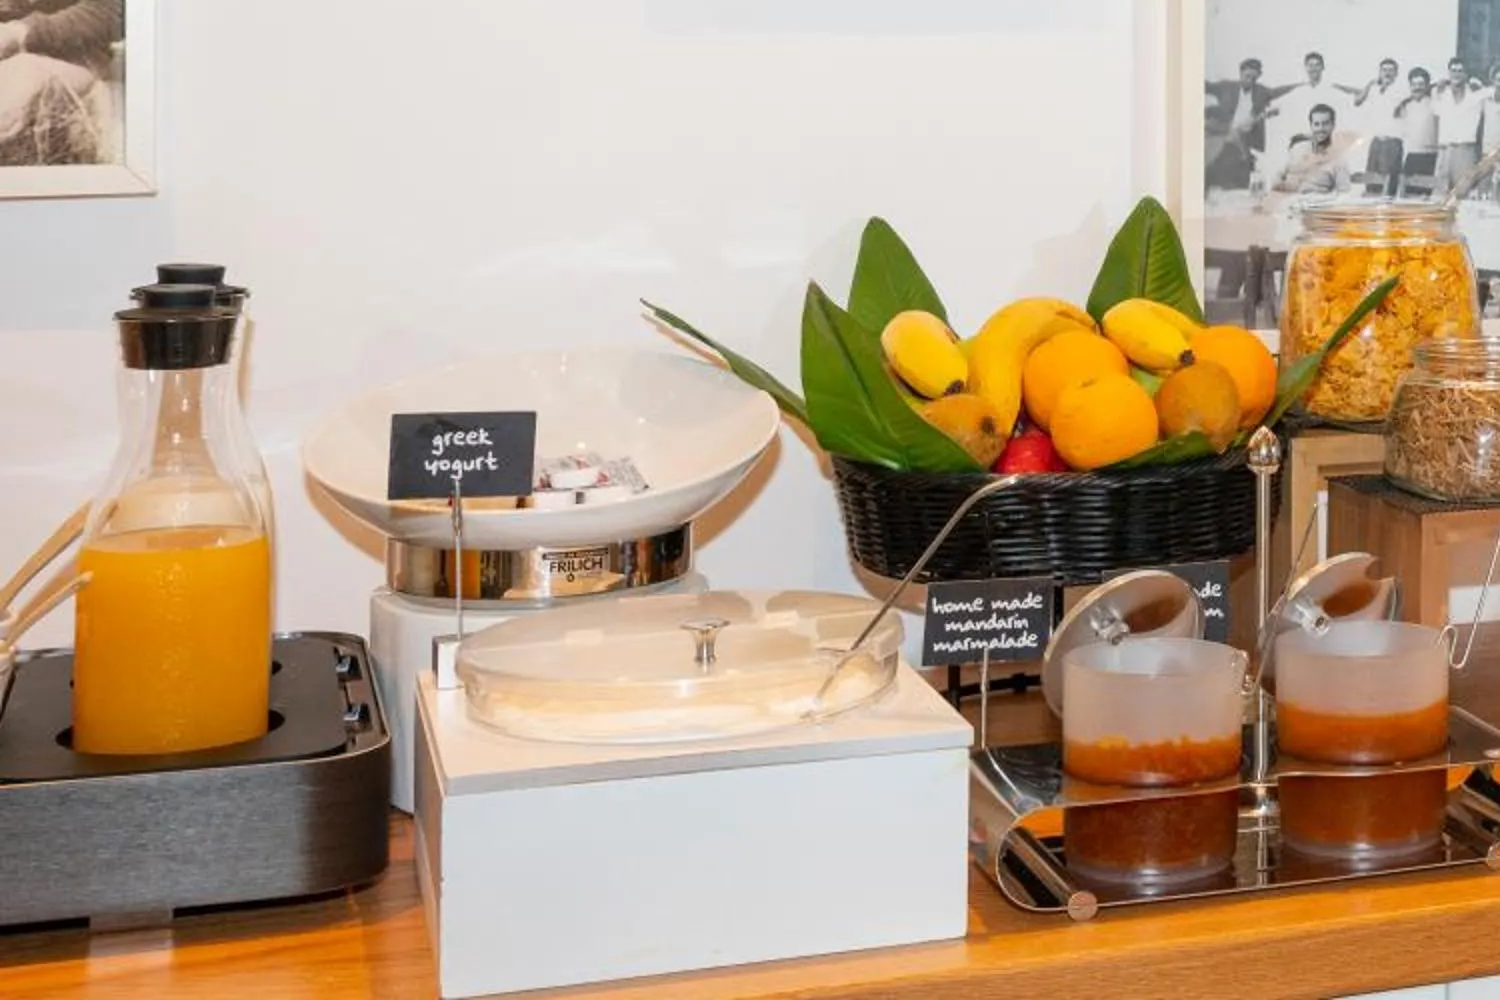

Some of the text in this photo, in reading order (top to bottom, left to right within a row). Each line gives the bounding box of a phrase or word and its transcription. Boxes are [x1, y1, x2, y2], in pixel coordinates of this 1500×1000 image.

[431, 428, 494, 456] greek
[424, 451, 499, 480] yogurt
[549, 557, 603, 573] FRILICH
[932, 592, 1043, 614] home made
[944, 612, 1029, 633] mandarin
[933, 630, 1039, 653] marmalade
